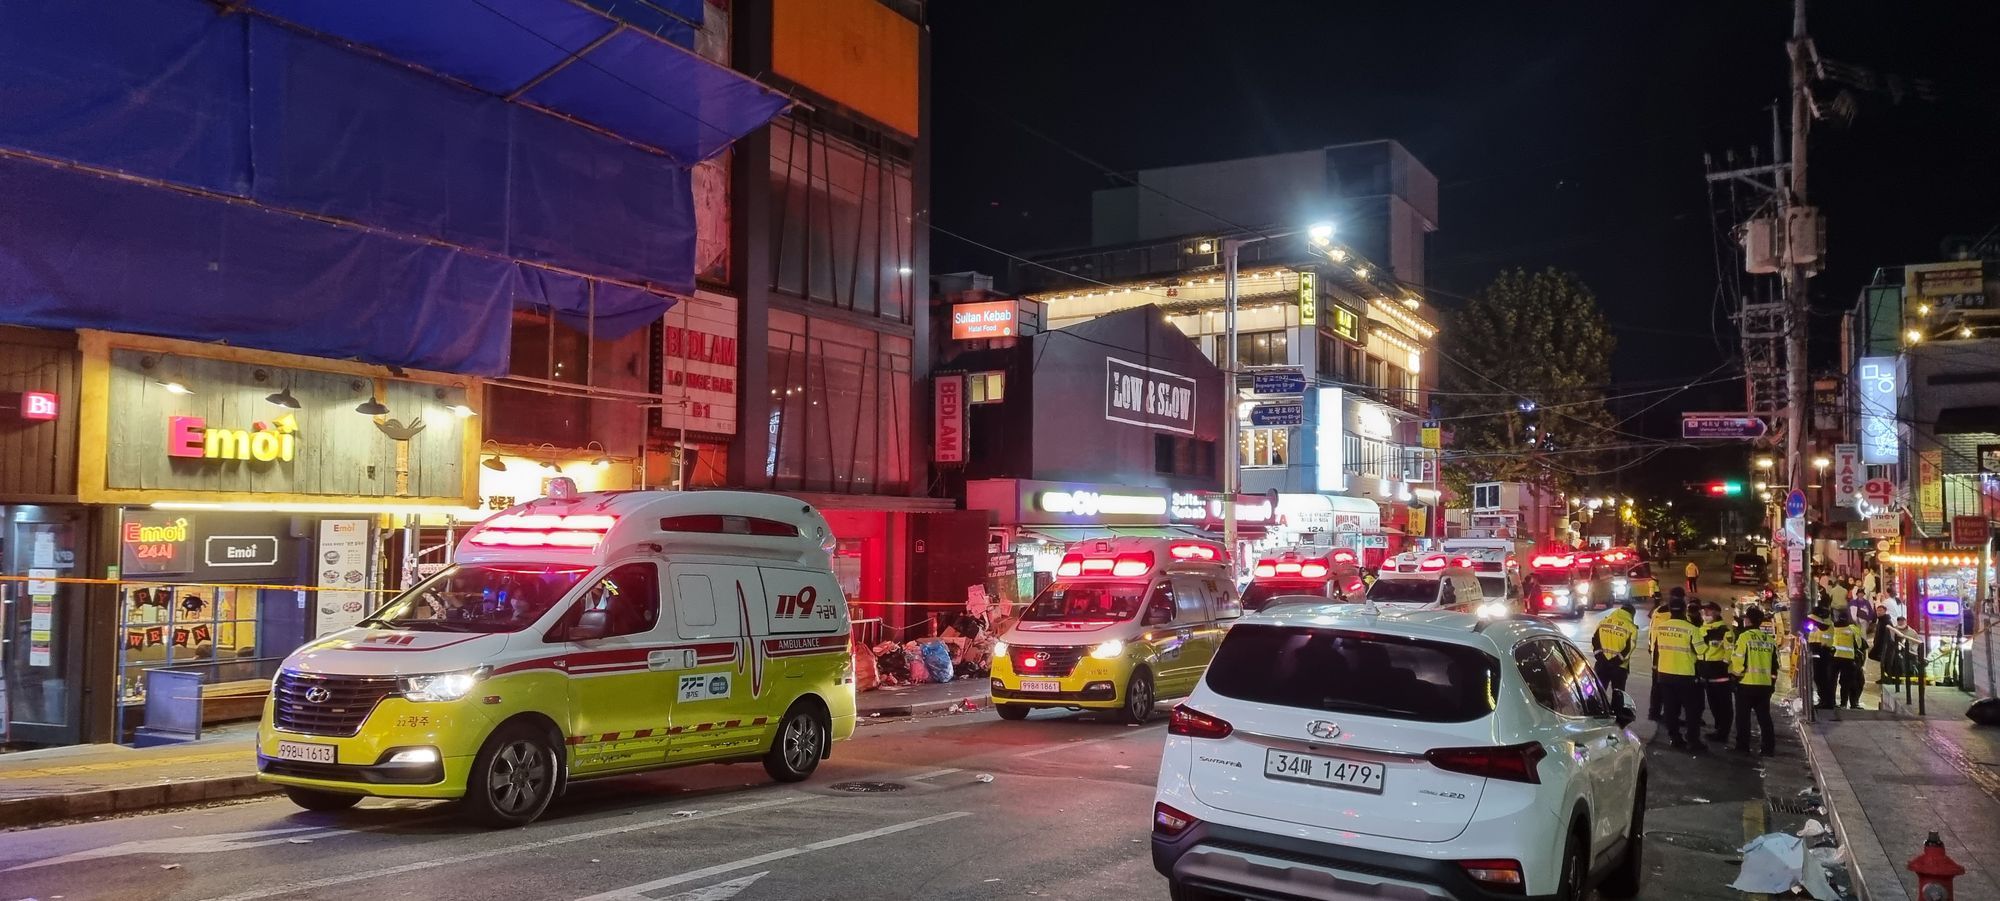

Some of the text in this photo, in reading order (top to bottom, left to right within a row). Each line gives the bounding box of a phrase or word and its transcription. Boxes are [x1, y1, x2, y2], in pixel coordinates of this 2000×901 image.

[955, 309, 1012, 324] Sultan Kebab
[28, 395, 57, 415] B1
[1113, 372, 1191, 421] LOW & SLOW
[692, 402, 710, 418] B1
[941, 382, 957, 447] BEDLAM
[1841, 454, 1854, 494] TACO
[1865, 481, 1892, 505] 약
[138, 543, 173, 559] 24시
[775, 585, 837, 619] 119 구급대
[1601, 628, 1624, 637] POLICE
[778, 638, 820, 649] AMBULANCE
[1041, 682, 1057, 690] 1861
[408, 716, 430, 728] 광주
[280, 744, 331, 761] 998나 1613
[1276, 754, 1372, 784] 34마 1479
